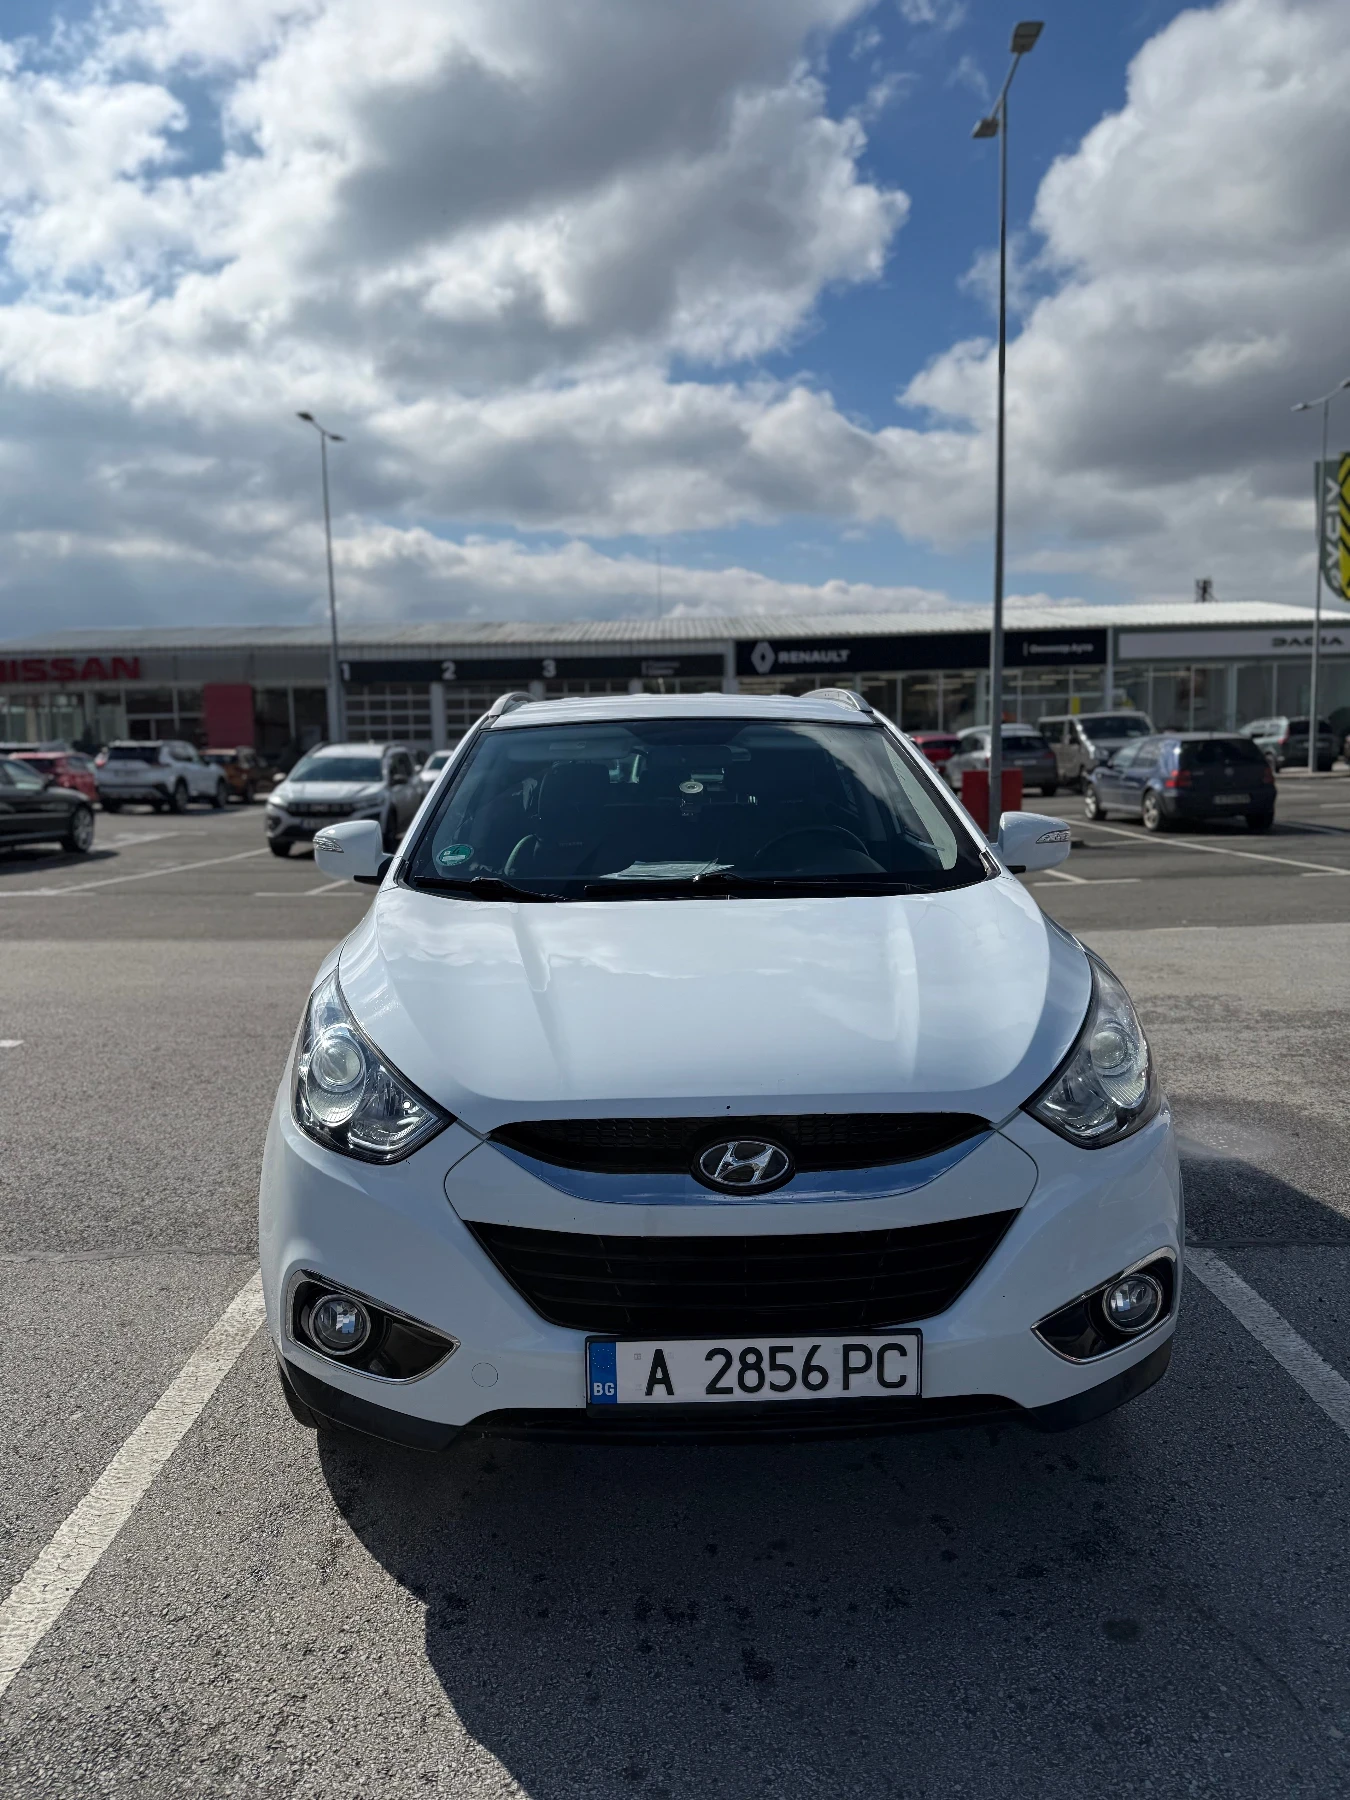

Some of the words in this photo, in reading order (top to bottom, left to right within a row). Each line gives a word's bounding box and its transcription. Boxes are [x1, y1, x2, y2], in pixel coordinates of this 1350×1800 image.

[1271, 635, 1344, 648] DACIA
[777, 648, 851, 665] RENAULT
[0, 656, 140, 683] ISSAN
[340, 662, 351, 681] 1
[441, 660, 457, 680] 2
[541, 659, 557, 678] 3
[644, 1348, 675, 1397] A
[703, 1344, 830, 1395] 2856
[841, 1342, 909, 1391] PC
[593, 1382, 616, 1397] BG
